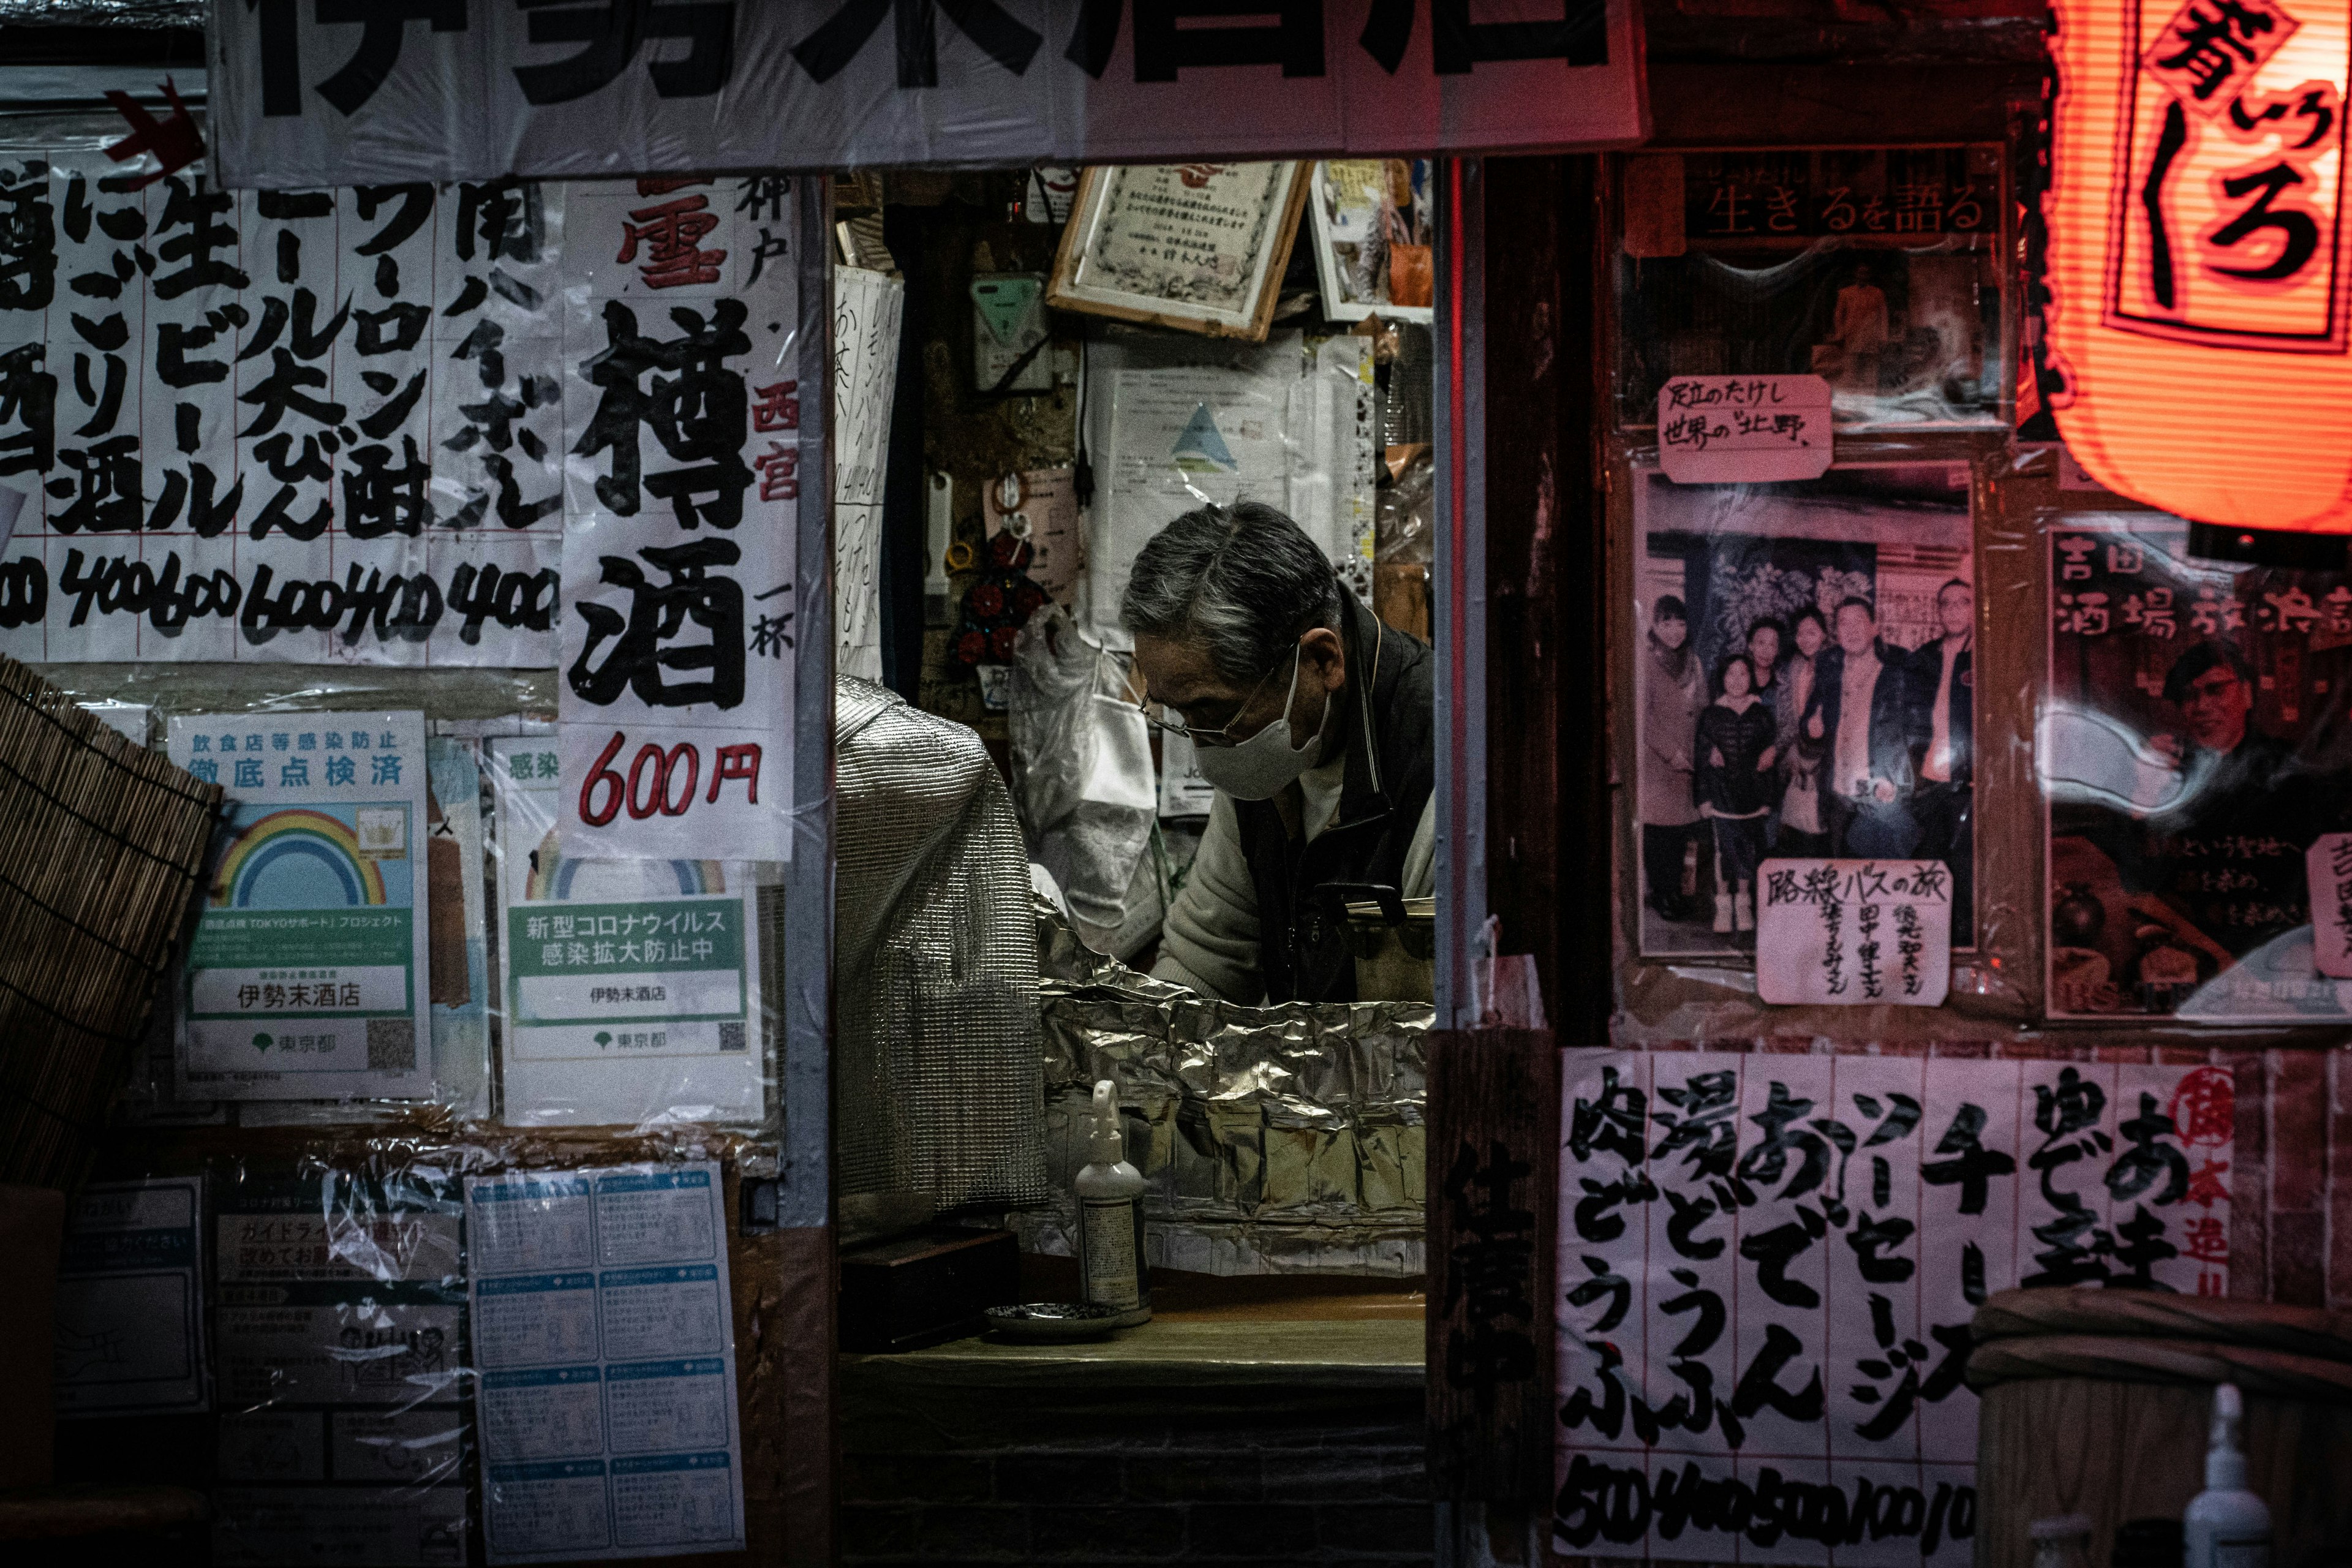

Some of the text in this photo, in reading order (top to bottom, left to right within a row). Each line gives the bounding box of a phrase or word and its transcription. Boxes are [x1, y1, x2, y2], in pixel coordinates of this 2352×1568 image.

[1705, 183, 1983, 233] 生きるを語る
[46, 176, 156, 535] にごり酒
[148, 175, 250, 538] 生ビール
[236, 189, 358, 542] ール大びん
[1667, 379, 1788, 410] 足立のたけし
[567, 297, 755, 710] 樽酒
[59, 548, 155, 627] 400
[153, 551, 242, 638] 600
[241, 564, 343, 646] 600
[450, 562, 560, 646] 400
[750, 583, 794, 660] 一杯
[191, 731, 398, 753] 飲食店等感染防止
[189, 753, 404, 791] 徹底点検済
[579, 730, 763, 829] 600円
[1766, 865, 1948, 908] 路線バスの旅
[526, 910, 727, 940] 新型コロナウイルス
[541, 937, 715, 966] 感染拡大防止中
[237, 982, 361, 1009] 伊勢末酒店
[589, 986, 666, 1005] 伊勢末酒店
[279, 1034, 336, 1053] 東京都
[617, 1031, 667, 1049] 東京都
[1558, 1066, 1659, 1446] 肉どうふ
[1846, 1093, 1929, 1441] ソーセージ
[1553, 1454, 1651, 1548] 500
[1649, 1461, 1753, 1540] 400
[1744, 1467, 1847, 1548] 500
